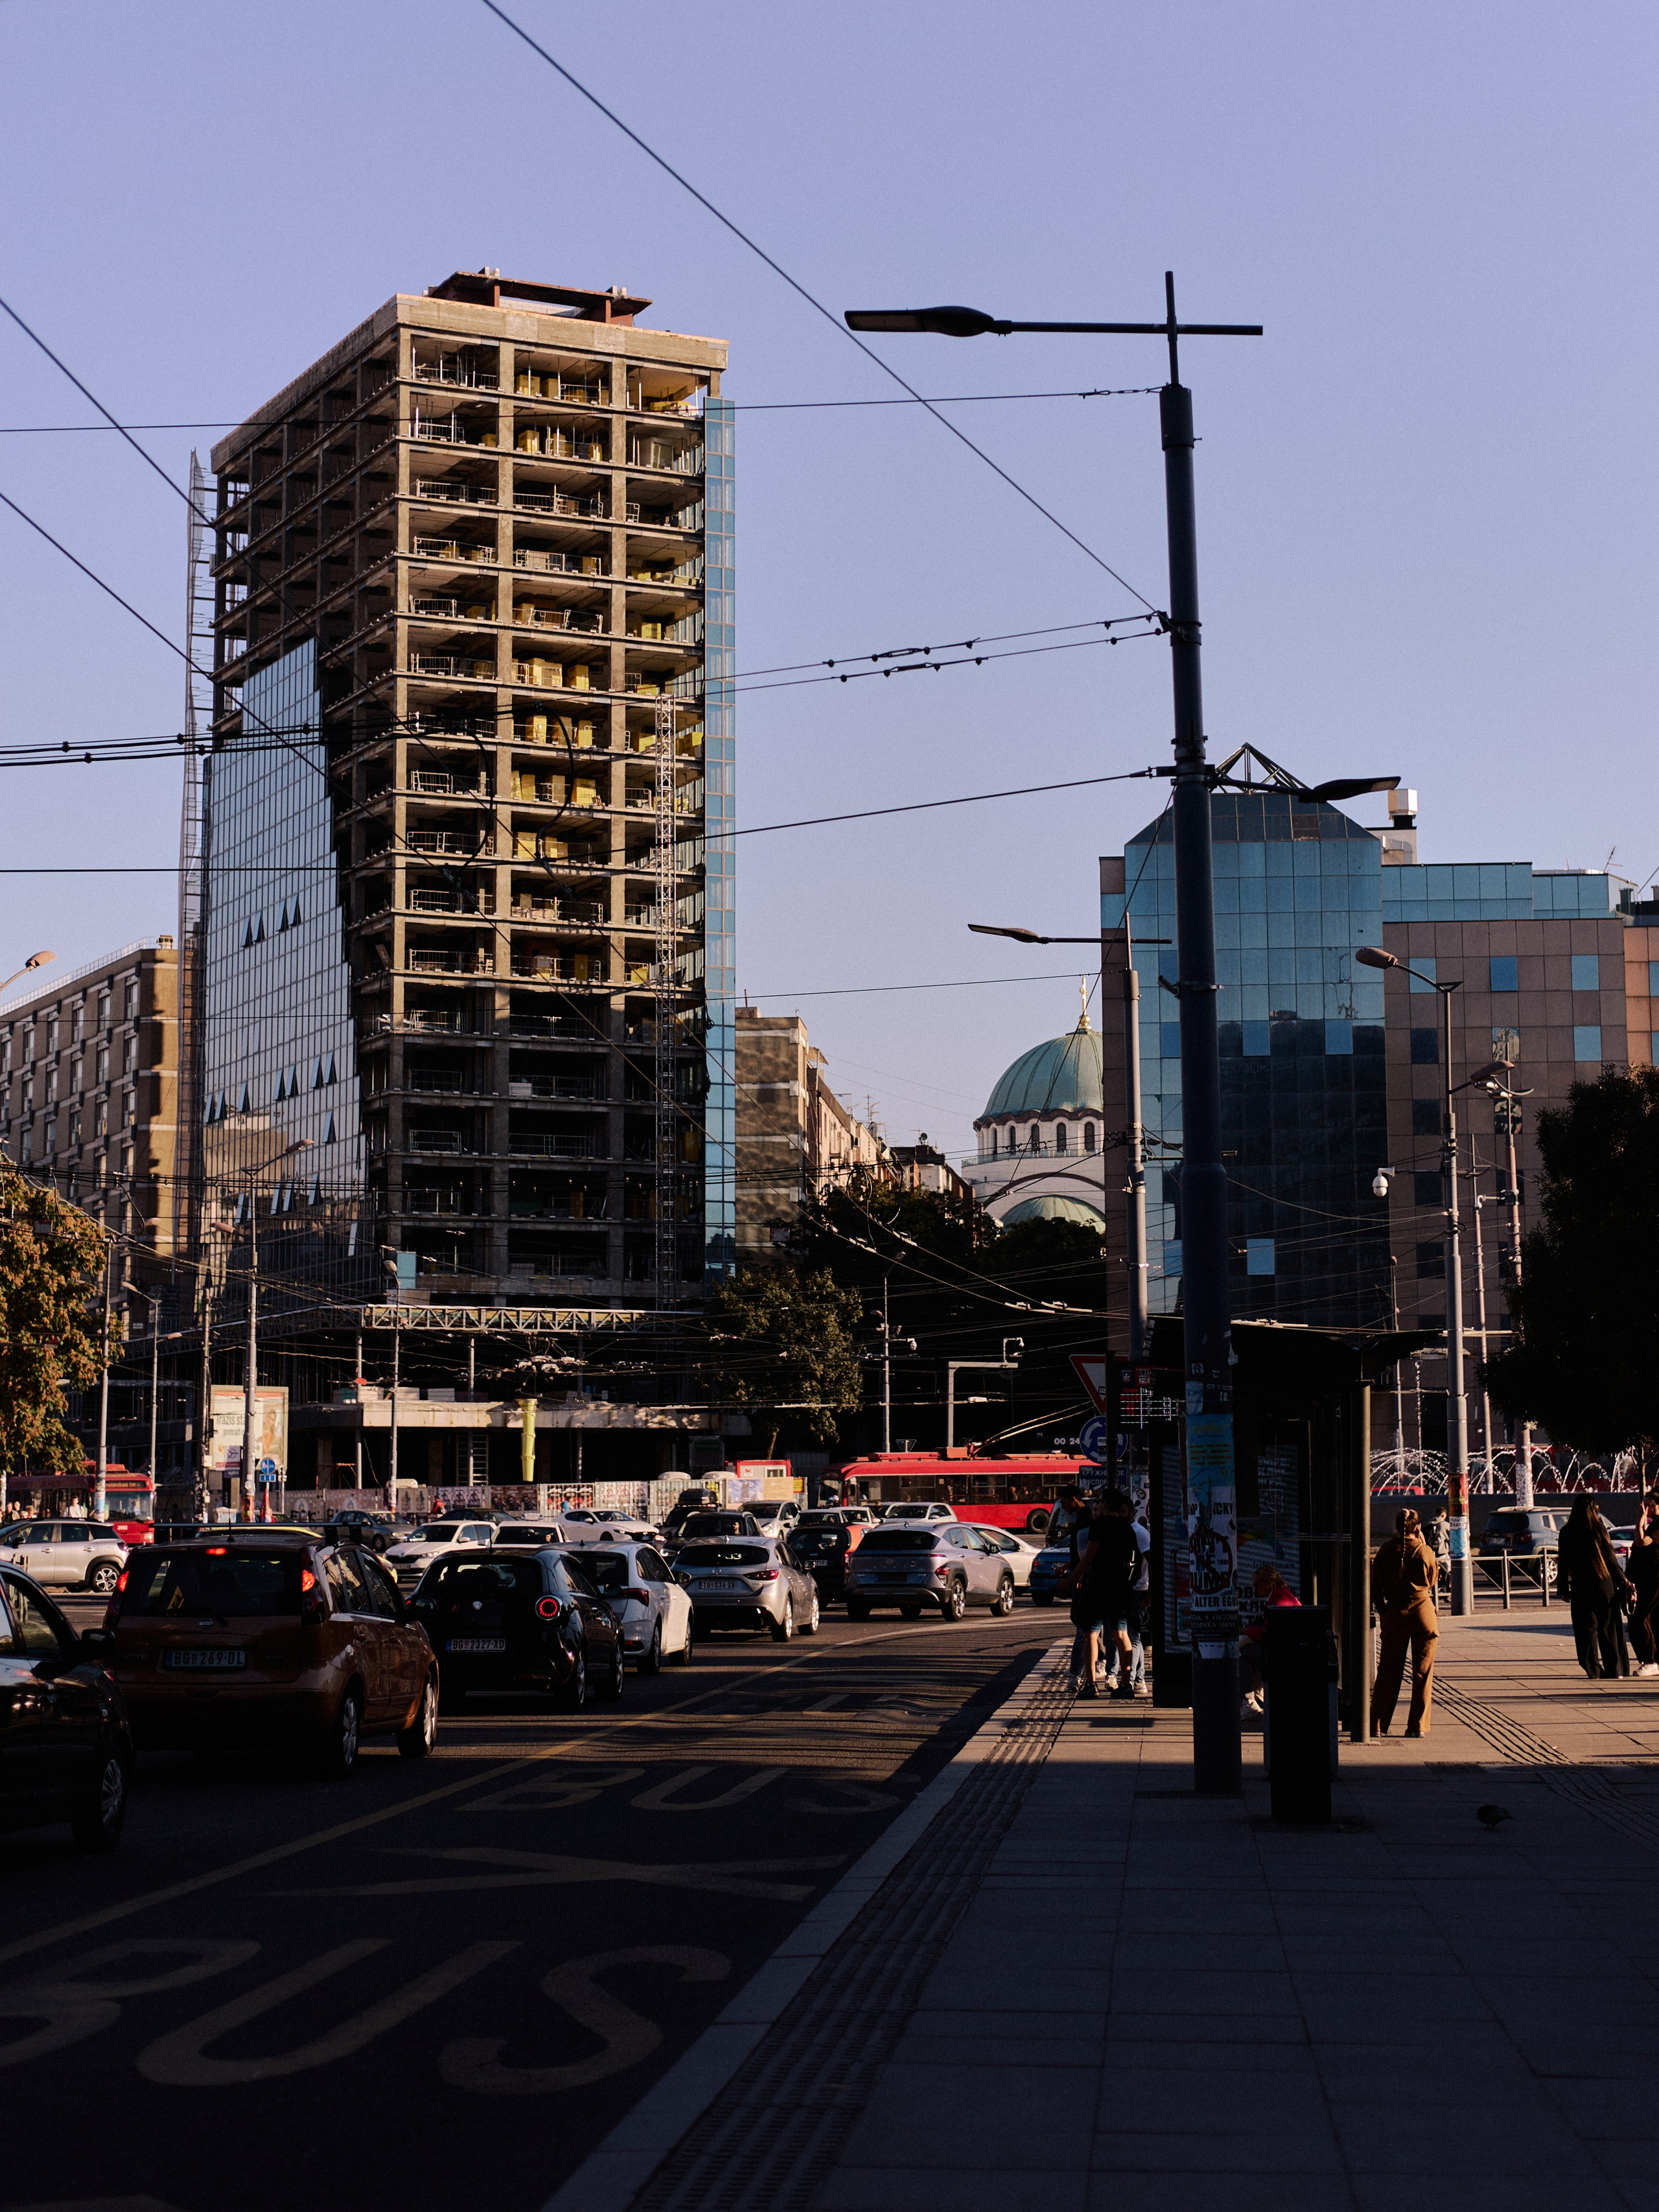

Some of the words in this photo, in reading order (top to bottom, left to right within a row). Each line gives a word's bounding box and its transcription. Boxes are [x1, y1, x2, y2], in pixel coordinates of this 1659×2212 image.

[1195, 1596, 1220, 1607] ALTER
[453, 1640, 463, 1649] BG
[174, 1652, 190, 1665] BG
